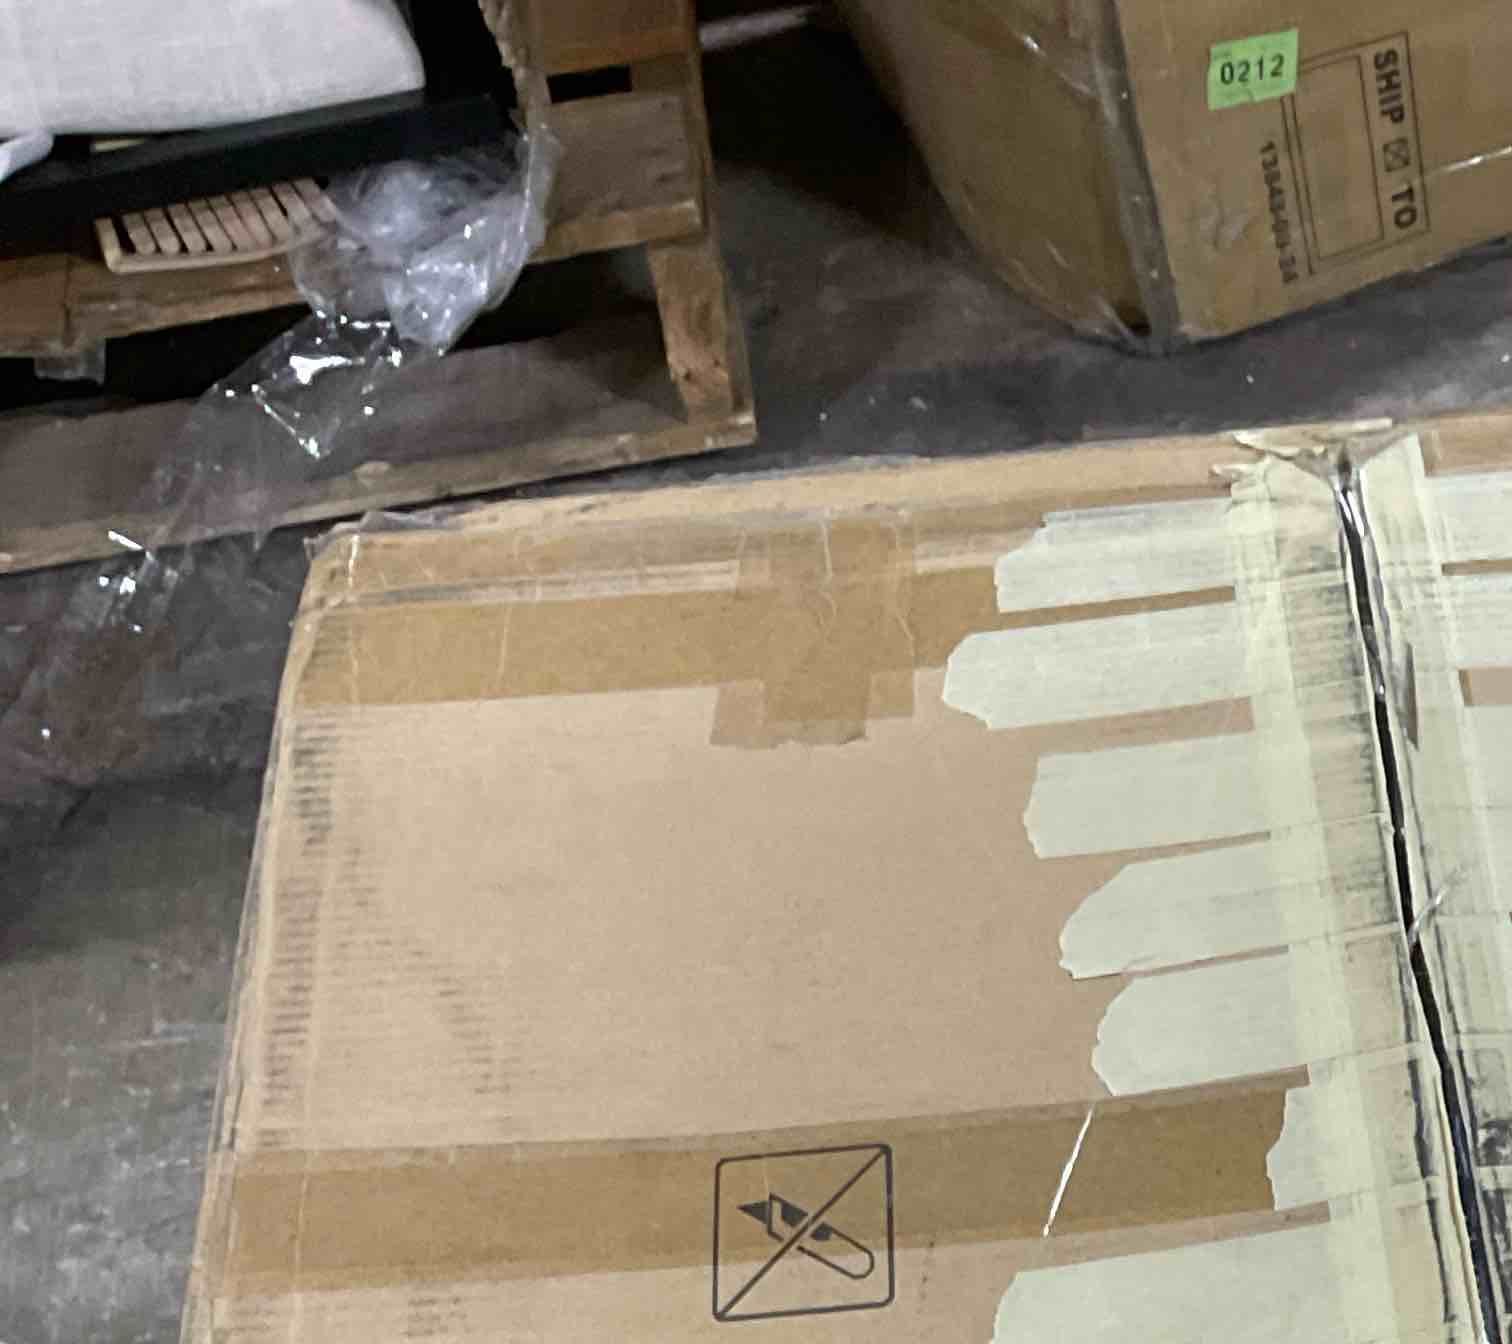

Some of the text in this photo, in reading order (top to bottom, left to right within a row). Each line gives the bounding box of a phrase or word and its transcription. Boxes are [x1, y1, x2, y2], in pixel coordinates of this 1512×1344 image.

[1219, 53, 1285, 86] 0212
[1374, 49, 1418, 230] SHIP TO
